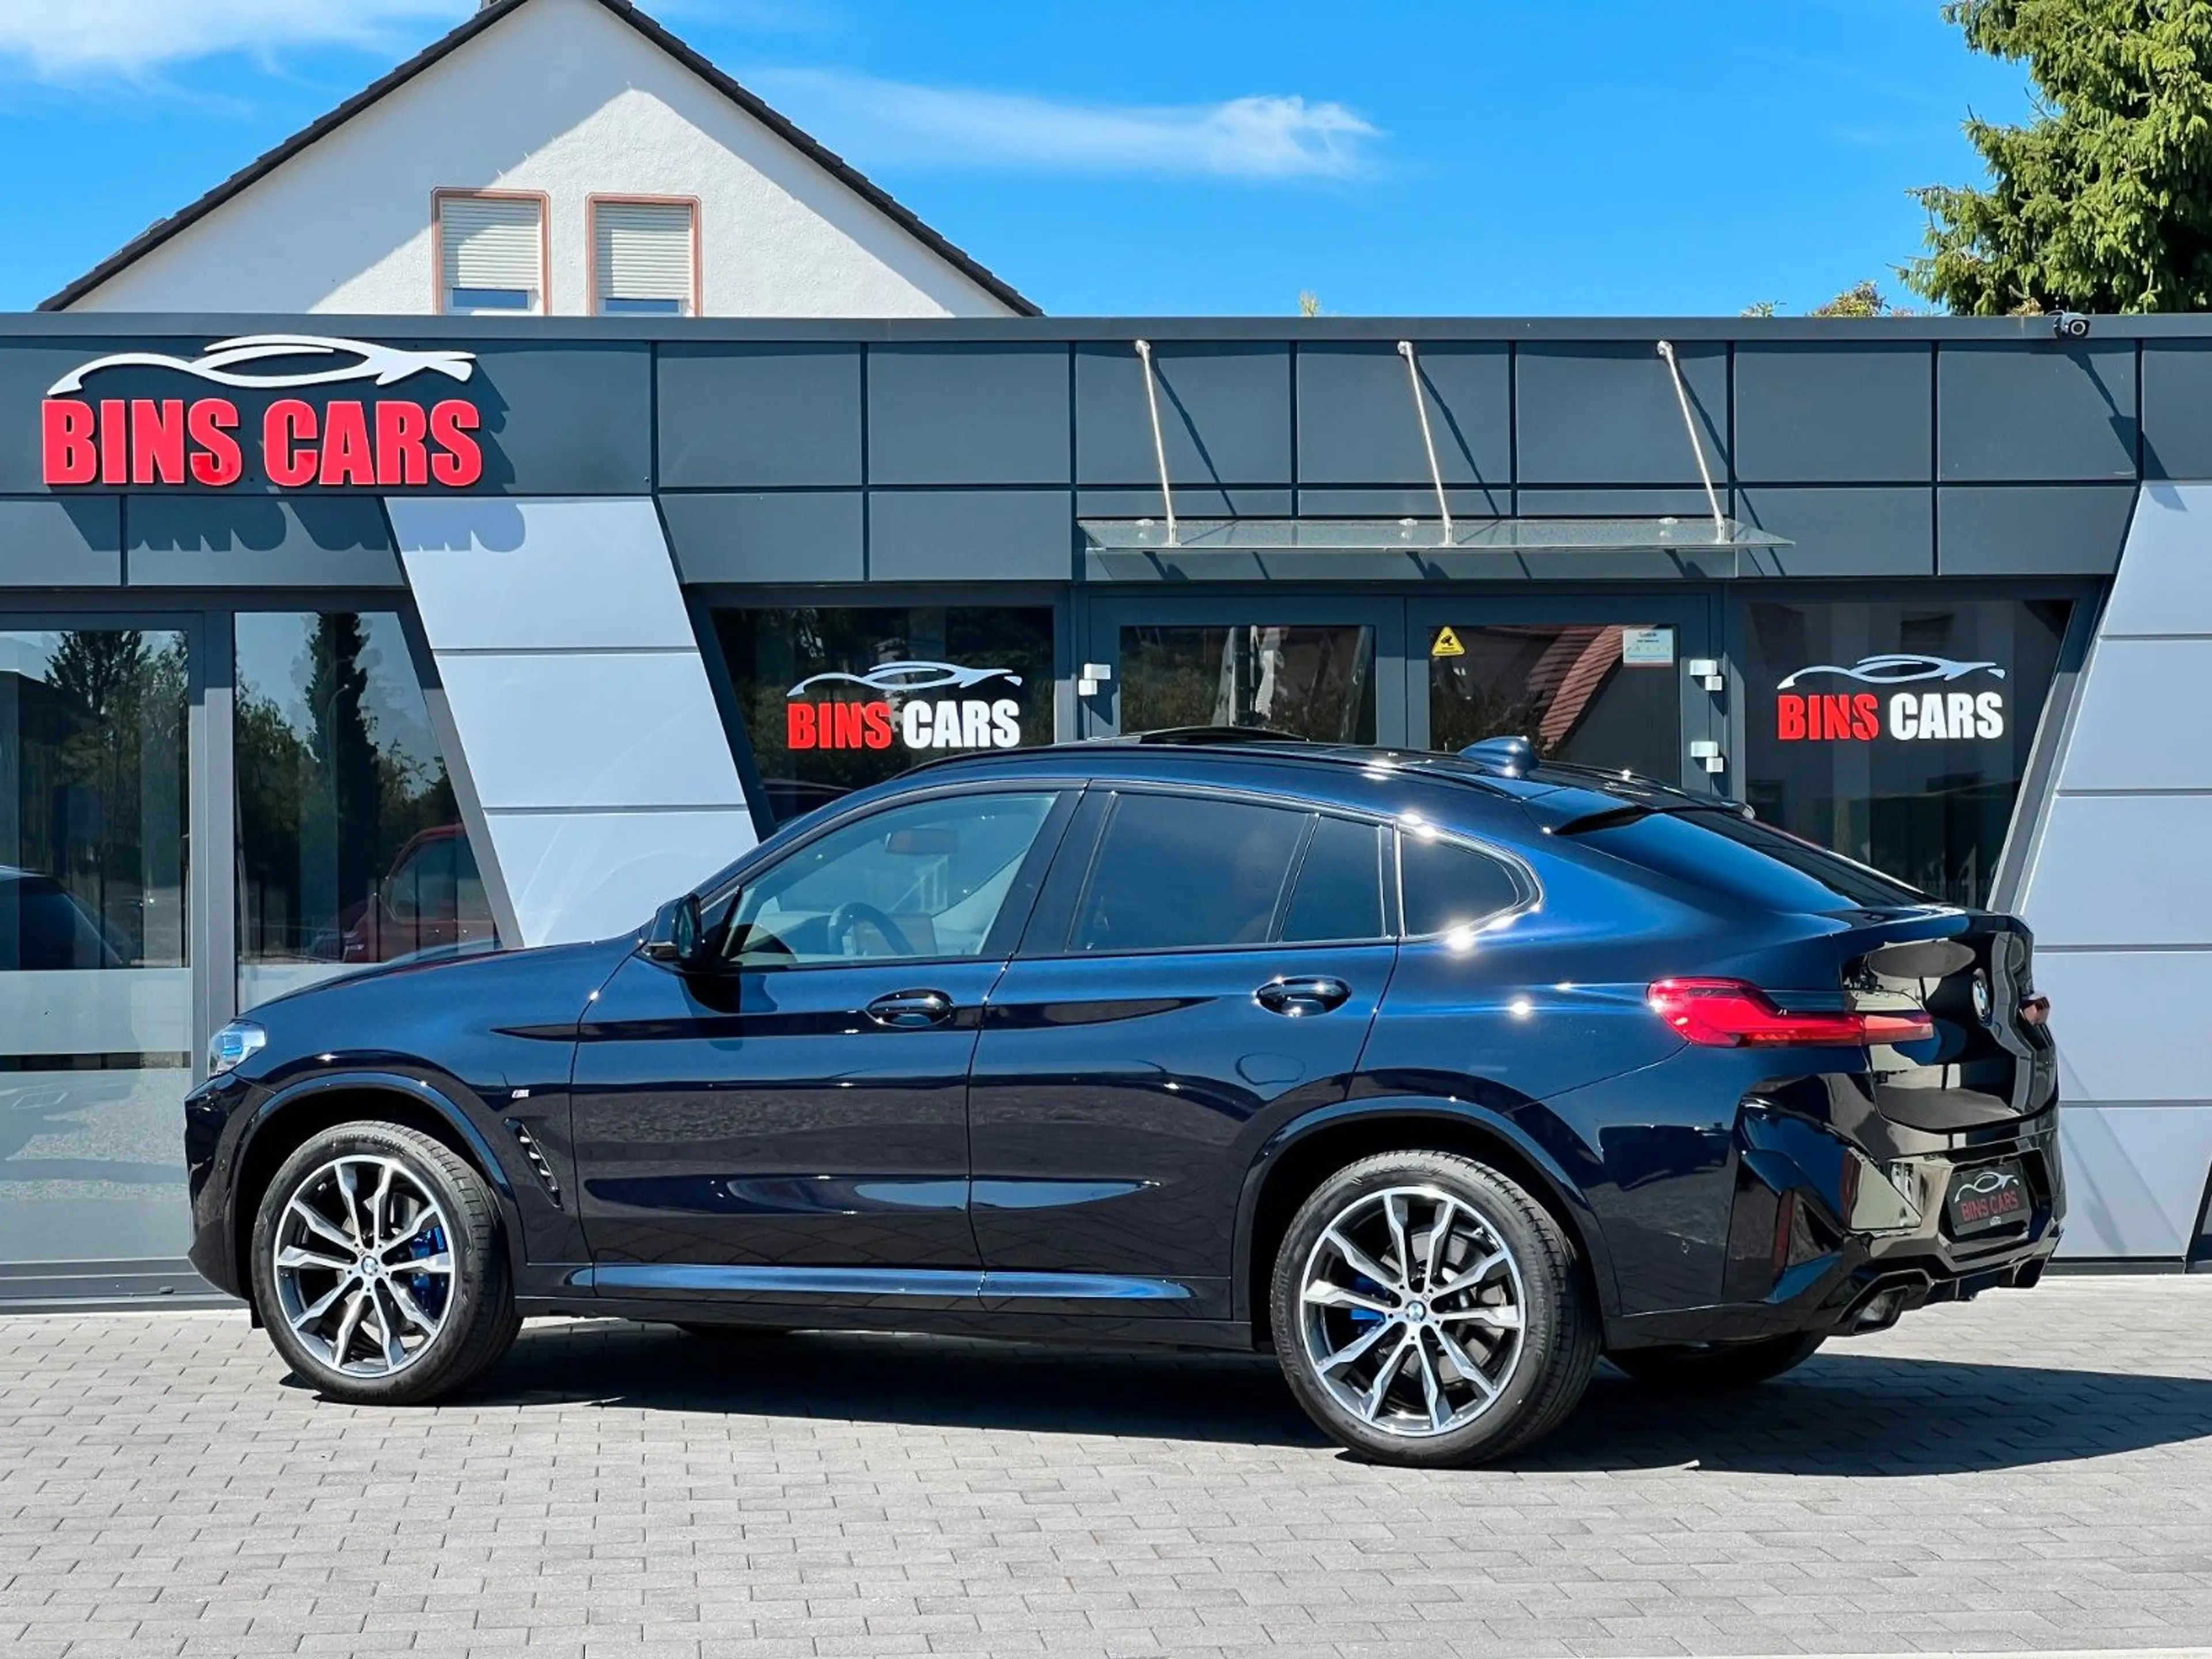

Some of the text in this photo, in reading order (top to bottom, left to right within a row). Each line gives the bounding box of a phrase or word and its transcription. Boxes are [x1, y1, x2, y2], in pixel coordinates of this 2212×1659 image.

[42, 398, 483, 487] BINS CARS
[786, 698, 1021, 750] BINS CARS
[1776, 691, 2004, 741] BINS CARS
[1961, 1199, 1988, 1221] BINS
[1990, 1190, 2019, 1214] CARS
